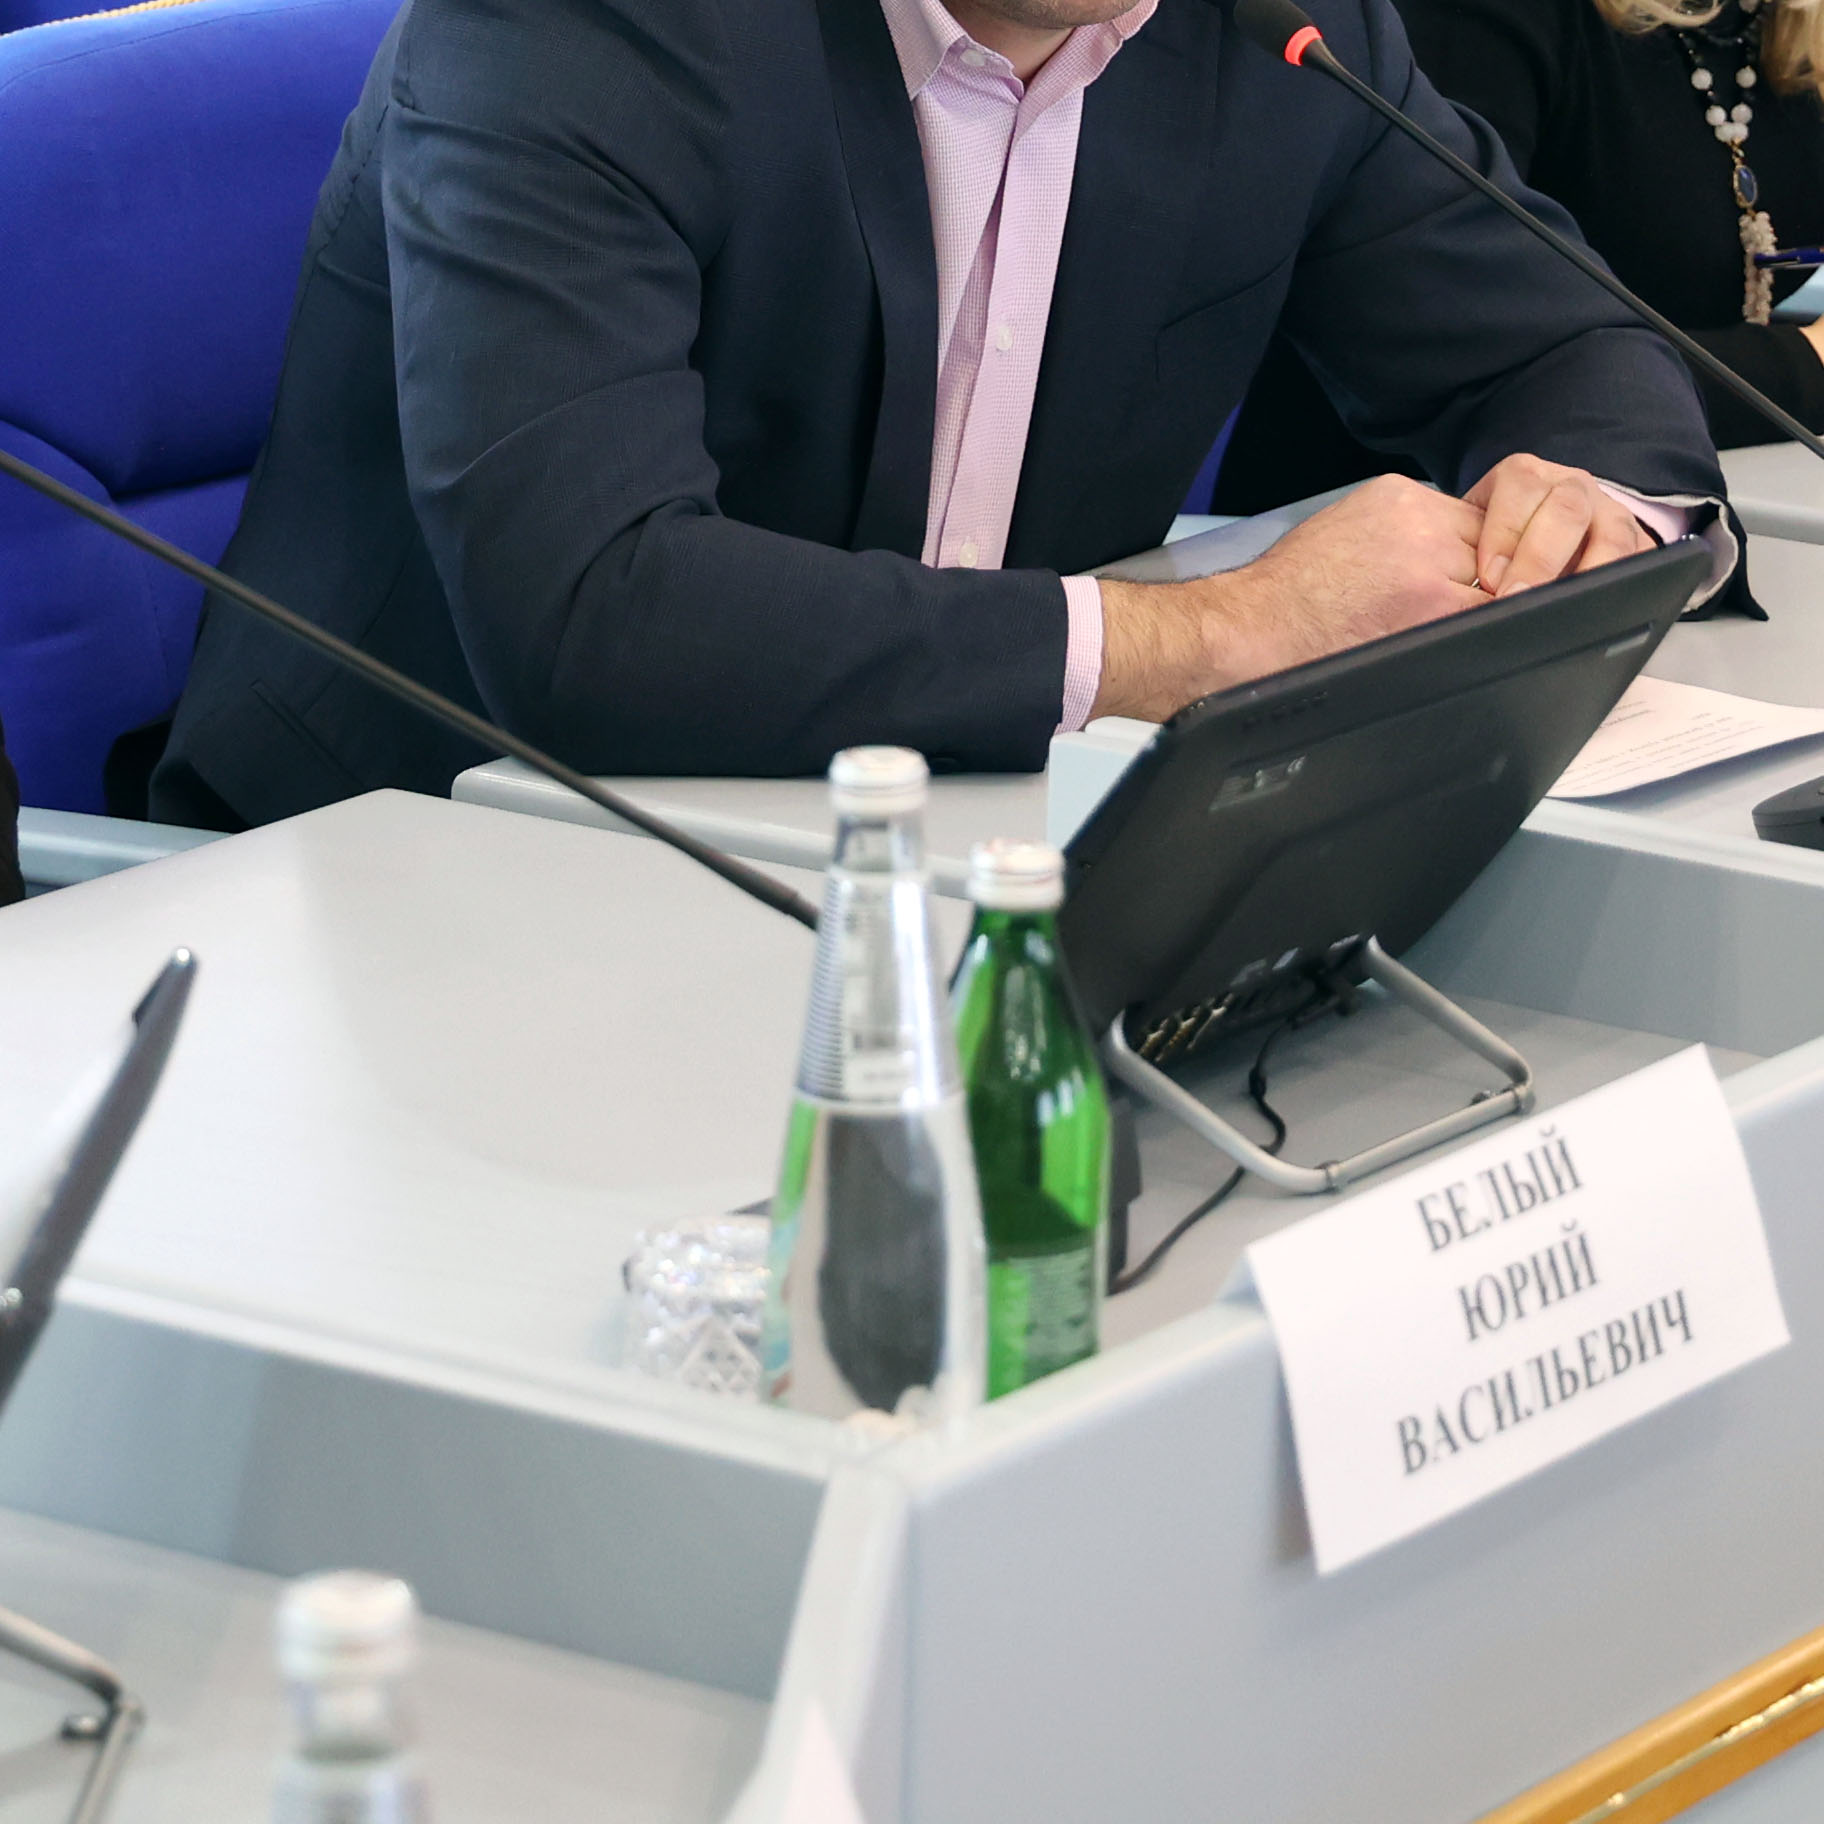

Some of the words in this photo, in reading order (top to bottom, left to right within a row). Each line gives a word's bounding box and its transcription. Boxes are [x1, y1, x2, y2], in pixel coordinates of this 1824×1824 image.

[1415, 1125, 1584, 1252] БЕЛЫЙ
[1457, 1219, 1599, 1341] ЮРИЙ
[1396, 1287, 1694, 1474] ВАСИЛЬЕВИЧ
